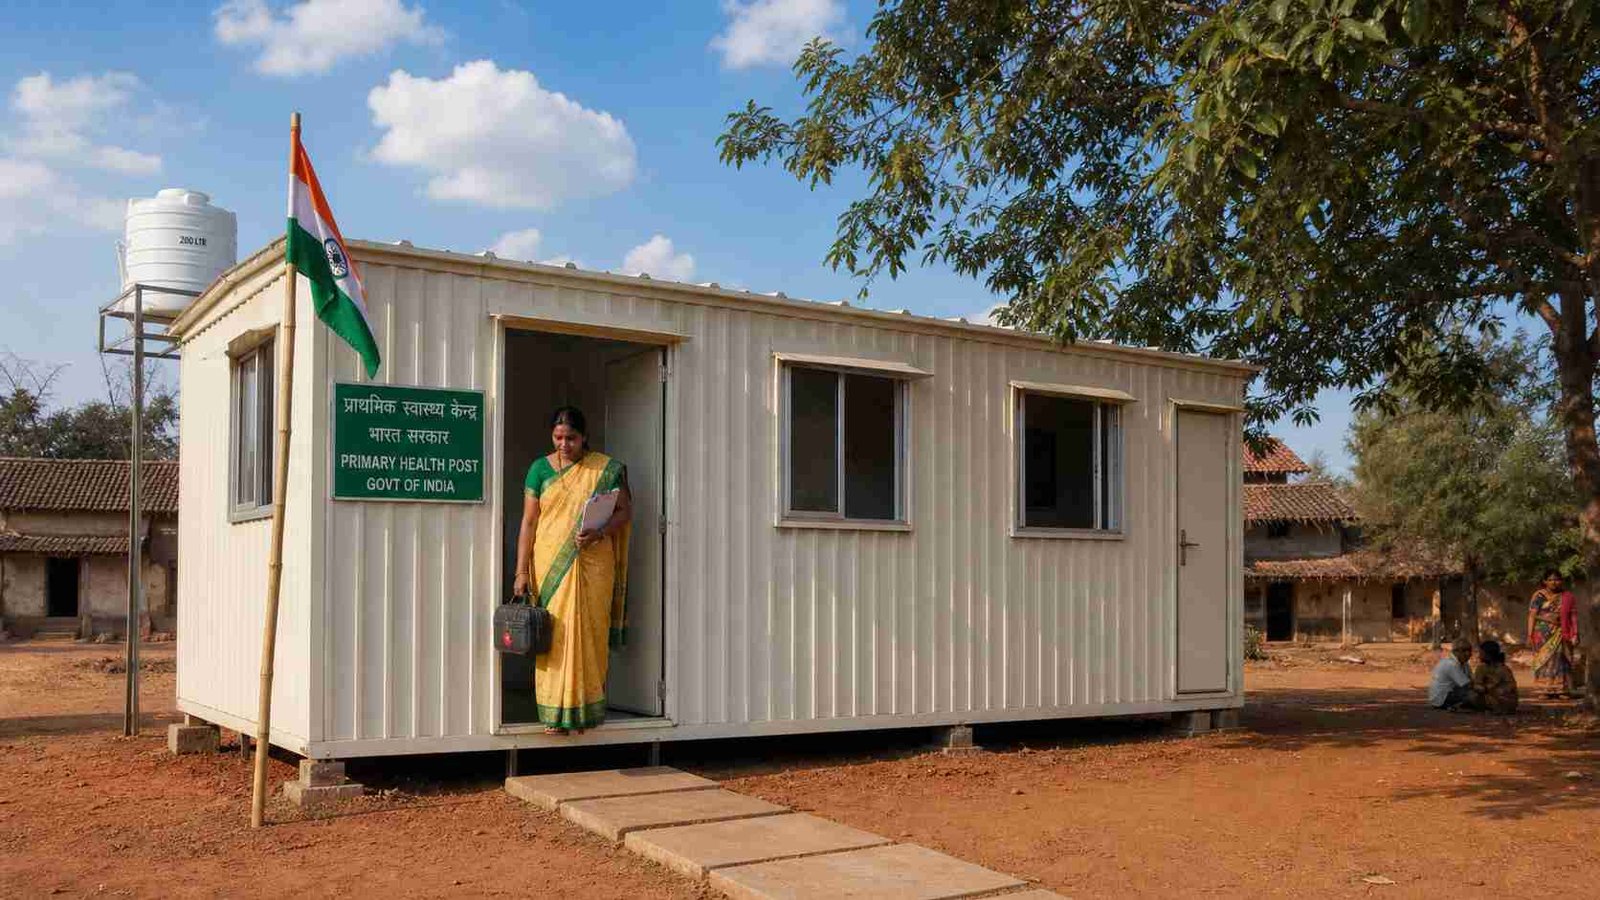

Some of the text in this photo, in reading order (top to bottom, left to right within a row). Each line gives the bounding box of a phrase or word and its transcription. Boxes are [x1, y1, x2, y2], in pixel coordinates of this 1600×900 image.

[179, 236, 193, 245] 200
[344, 394, 397, 414] प्राथमिक
[450, 399, 477, 421] केन्द्र
[369, 427, 450, 445] भारत सरकार
[341, 454, 479, 472] PRIMARY HEALTH POST
[366, 478, 455, 493] GOVT OF INDIA
